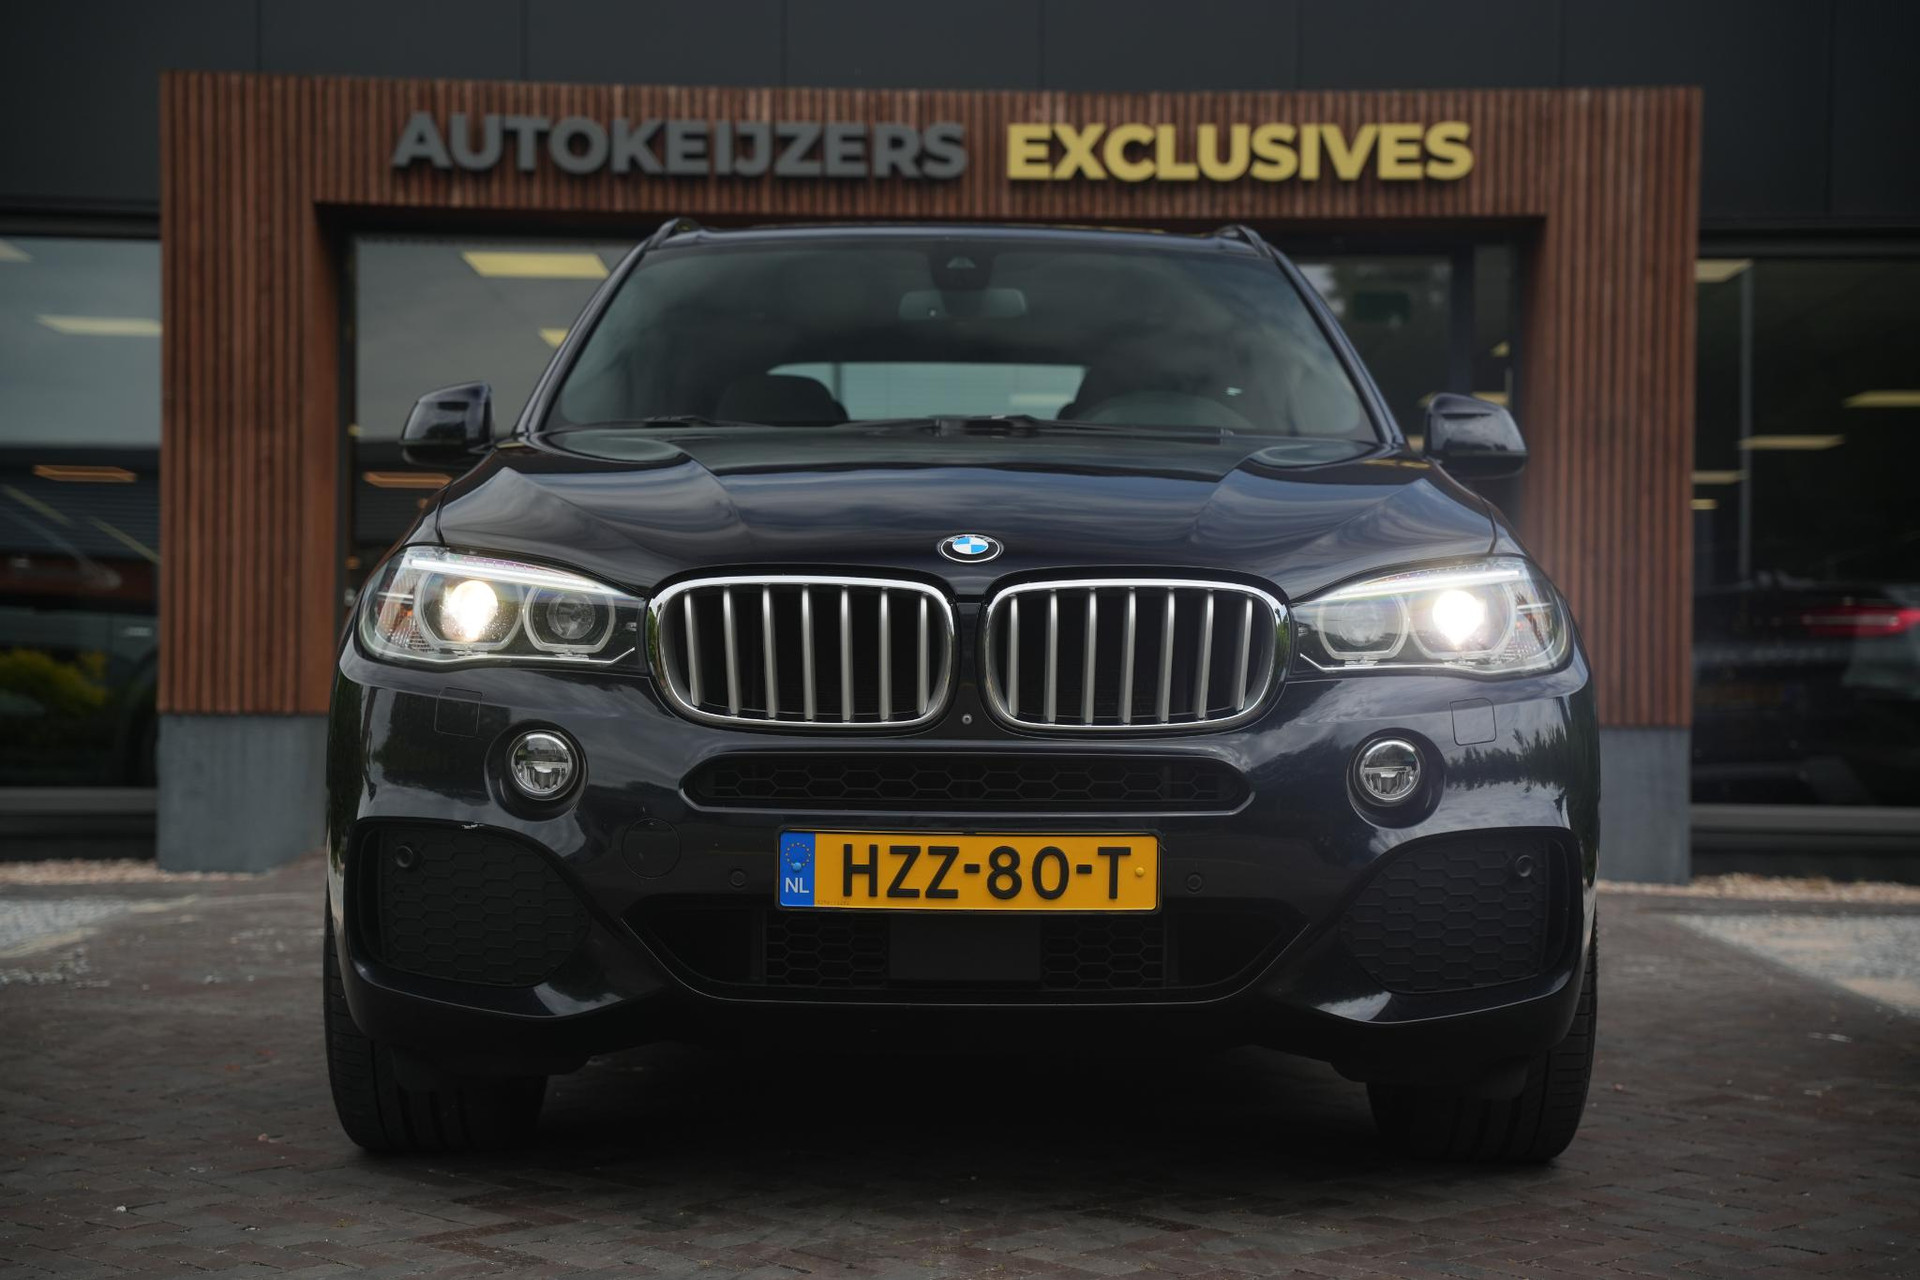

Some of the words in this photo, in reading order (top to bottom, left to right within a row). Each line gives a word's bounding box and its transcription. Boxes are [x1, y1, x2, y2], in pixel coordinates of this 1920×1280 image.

[392, 111, 969, 179] AUTOKEIJZERS
[1006, 121, 1475, 182] EXCLUSIVES
[785, 877, 810, 893] NL
[842, 843, 1132, 900] HZZ-80-T
